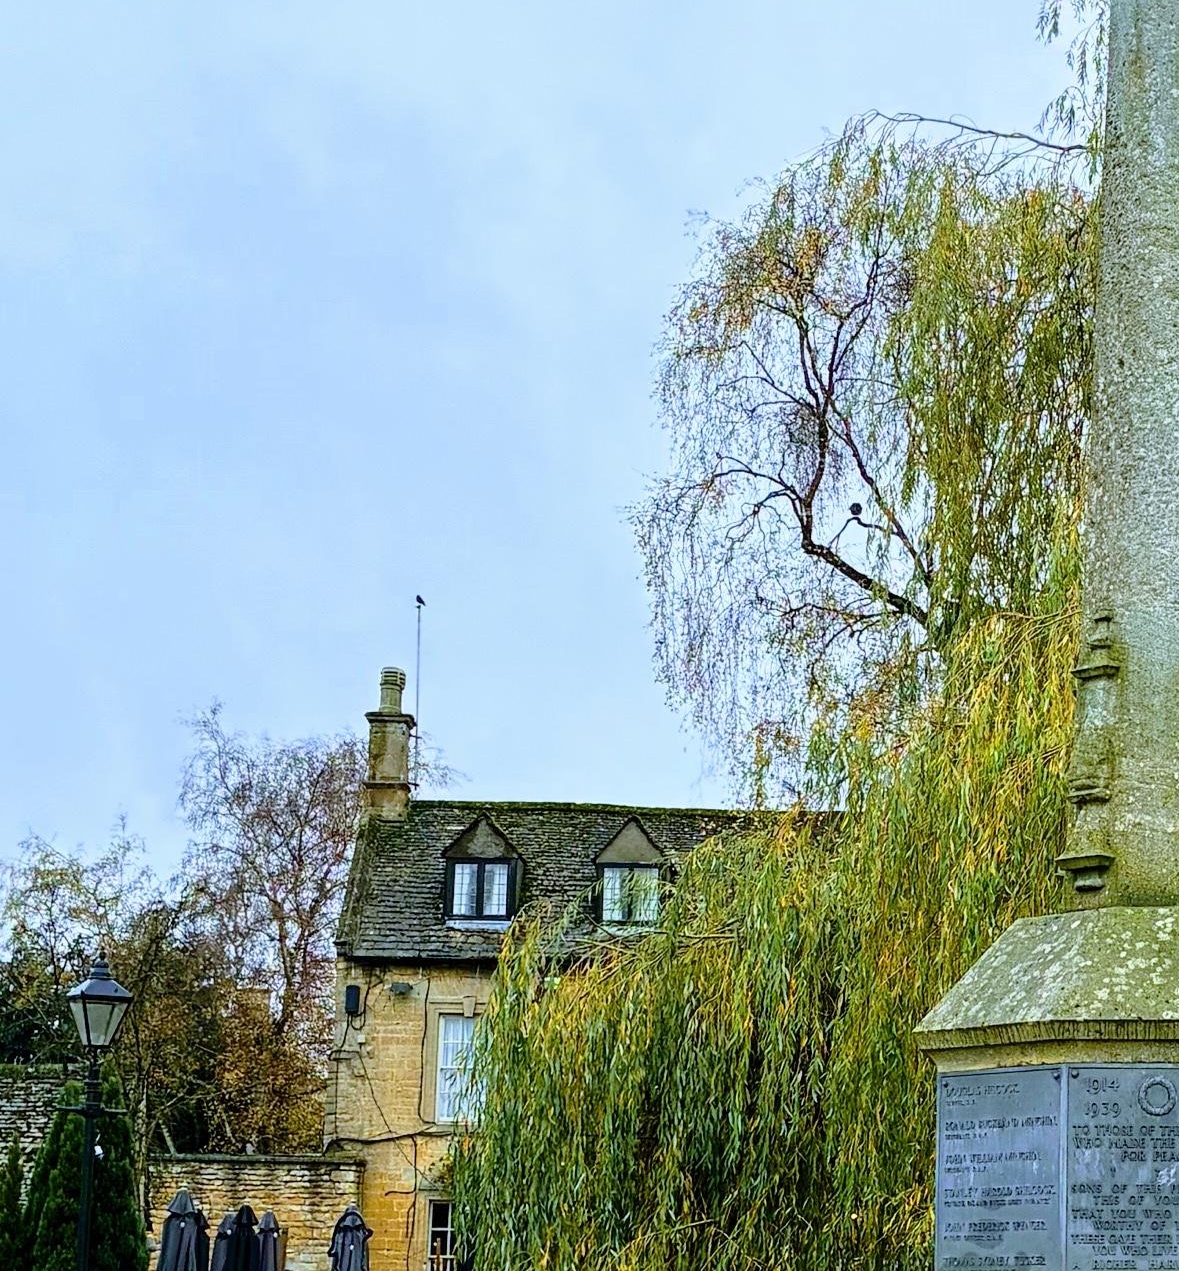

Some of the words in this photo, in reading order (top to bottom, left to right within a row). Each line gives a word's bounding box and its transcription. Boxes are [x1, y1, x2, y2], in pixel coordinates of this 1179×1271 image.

[1086, 1078, 1120, 1095] 1914
[1084, 1102, 1121, 1118] 1939
[1072, 1125, 1090, 1137] TO
[1094, 1125, 1134, 1137] THOSE
[1140, 1125, 1155, 1137] OF
[1072, 1138, 1102, 1150] WHO
[1108, 1138, 1146, 1150] MADE
[1151, 1138, 1176, 1150] THE
[1121, 1151, 1147, 1163] FOR
[1071, 1184, 1103, 1195] SONS
[1111, 1184, 1128, 1195] OF
[1135, 1184, 1163, 1195] THIS
[1093, 1195, 1121, 1206] THIS
[1128, 1195, 1145, 1206] OF
[1154, 1195, 1179, 1206] YOU
[1071, 1209, 1104, 1220] THAT
[1110, 1209, 1137, 1220] YOU
[1143, 1209, 1172, 1220] WHO
[1092, 1220, 1143, 1231] WORTHY
[1151, 1220, 1166, 1231] OF
[1071, 1234, 1106, 1245] THESE
[1139, 1234, 1173, 1245] THEIR
[1092, 1245, 1117, 1257] YOU
[1120, 1245, 1148, 1257] WHO
[1152, 1245, 1178, 1257] LIVE
[1092, 1259, 1137, 1271] RICHER
